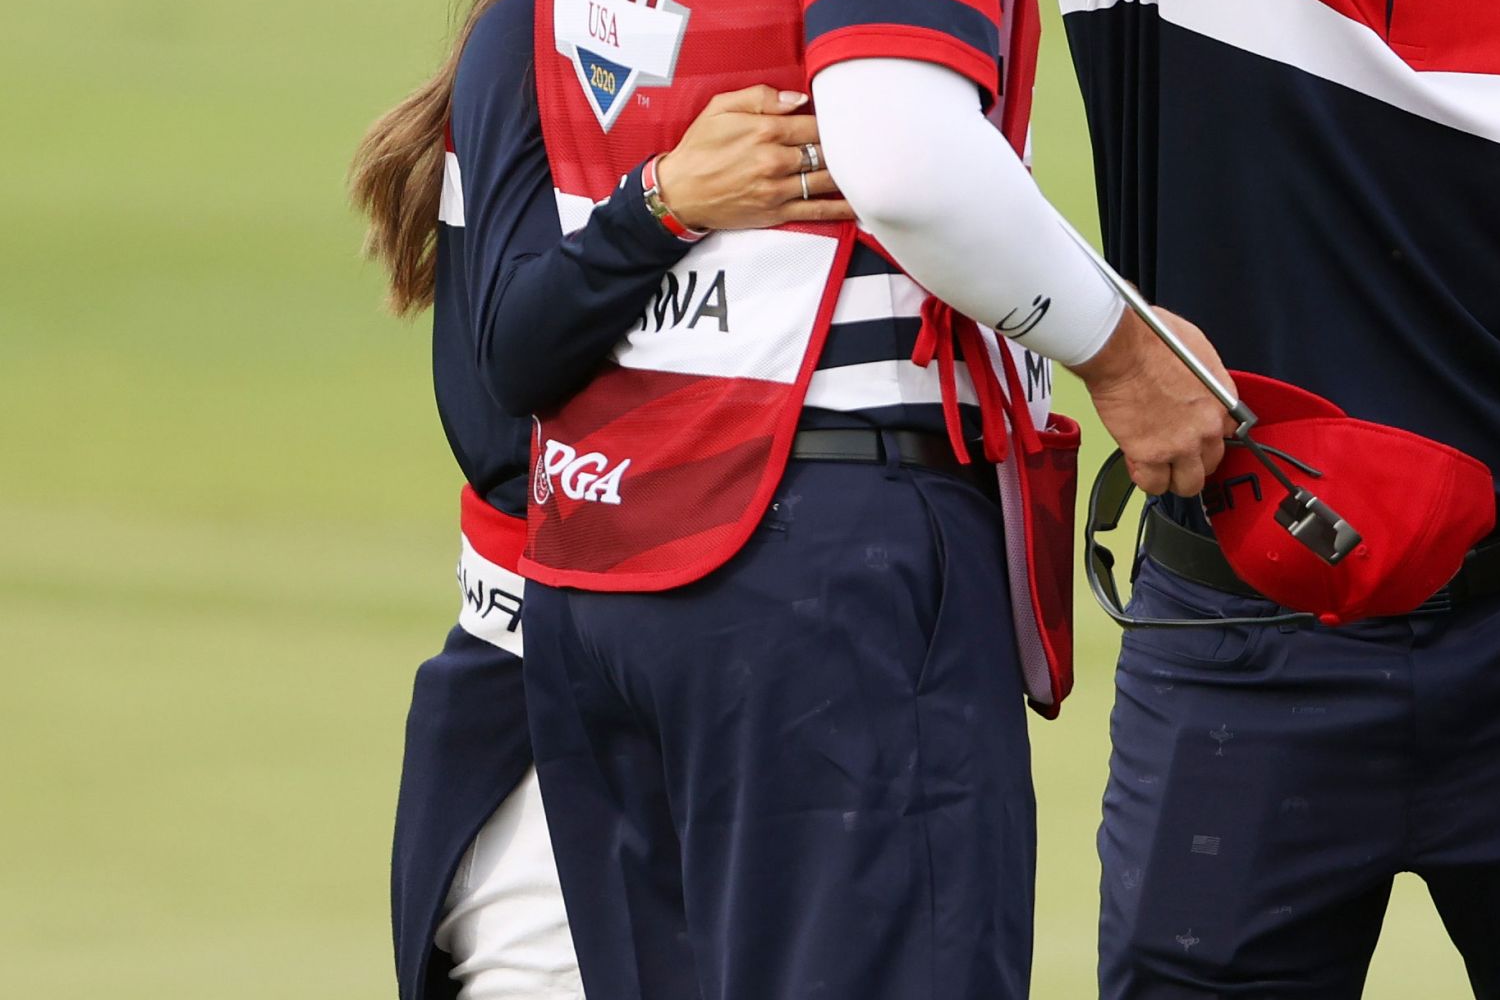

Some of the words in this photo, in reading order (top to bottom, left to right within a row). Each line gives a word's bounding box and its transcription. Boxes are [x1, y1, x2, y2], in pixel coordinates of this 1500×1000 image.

[589, 1, 620, 48] USA
[590, 63, 616, 95] 2020
[640, 270, 729, 333] WA
[544, 439, 632, 505] PGA
